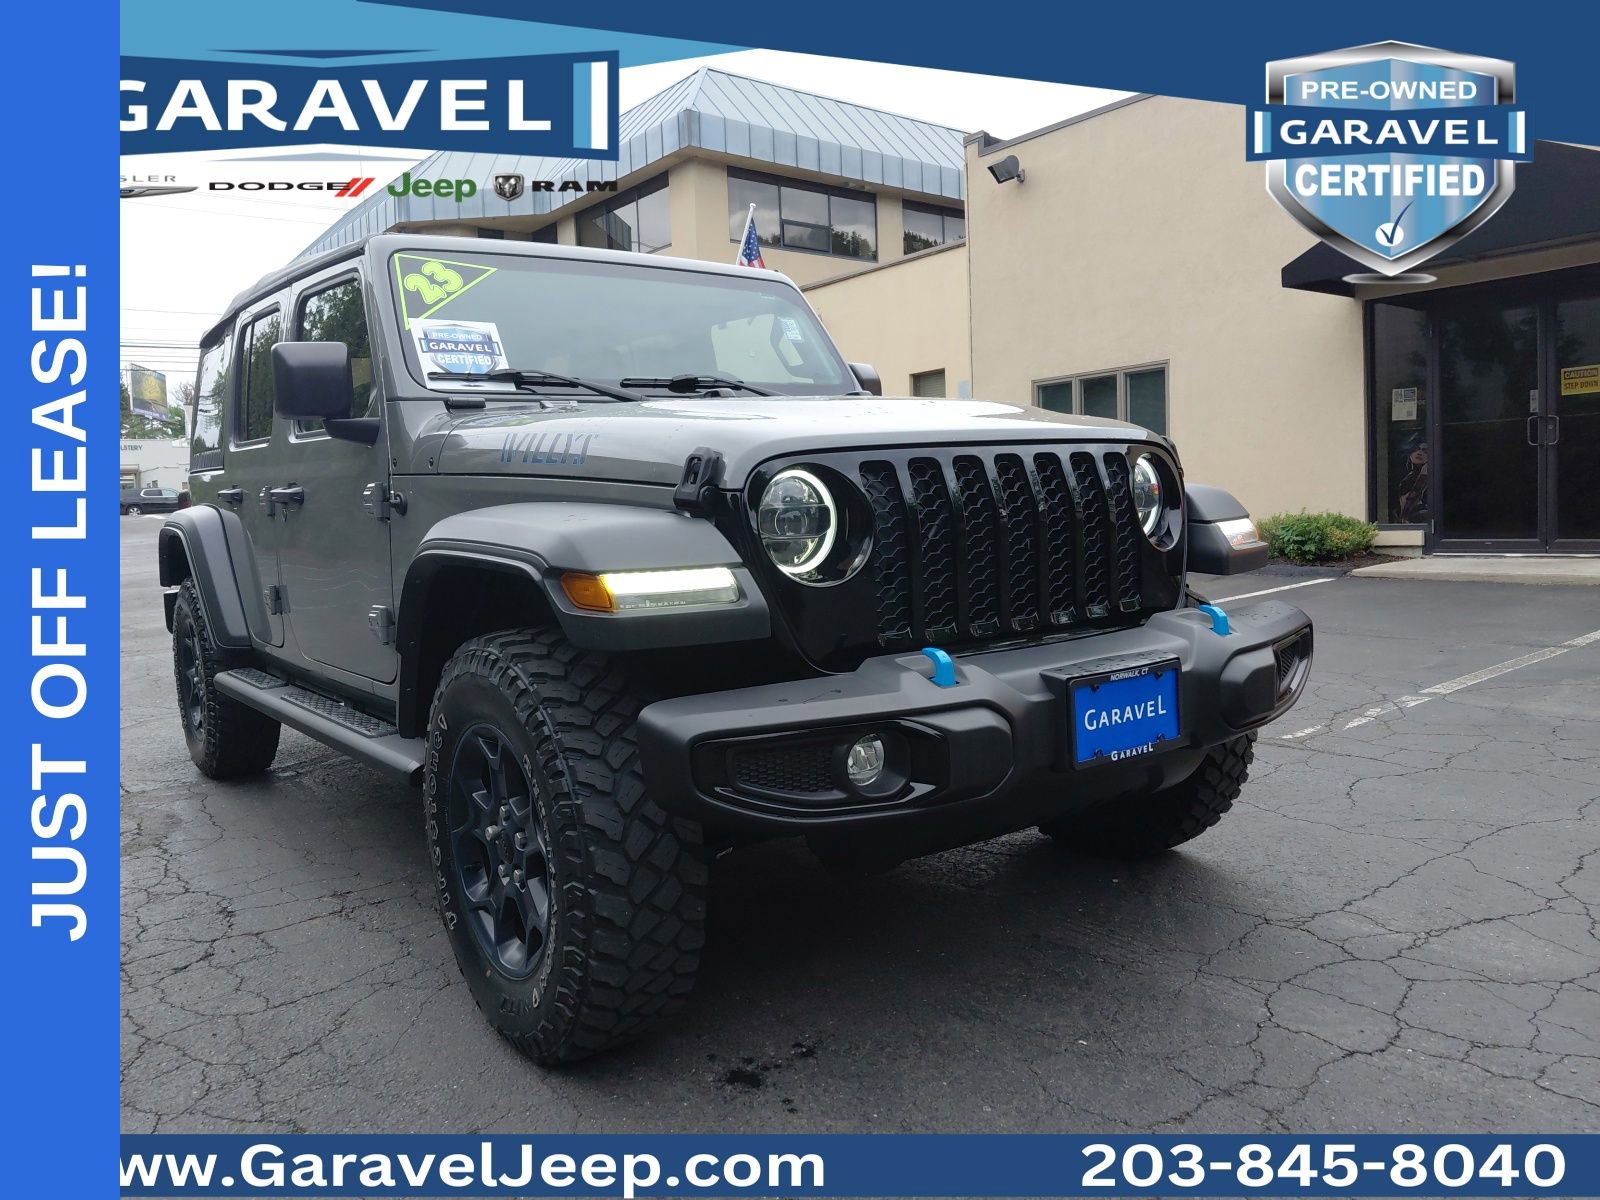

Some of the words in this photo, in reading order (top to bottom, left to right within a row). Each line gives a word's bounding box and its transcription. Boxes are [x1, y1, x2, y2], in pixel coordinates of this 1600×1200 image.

[403, 260, 464, 305] 23
[429, 341, 493, 353] GARAVEL
[436, 354, 493, 366] CERTIFIED
[1565, 369, 1598, 379] CAUTION
[1084, 695, 1167, 731] GARAVEL
[1111, 742, 1154, 762] GARAVEL
